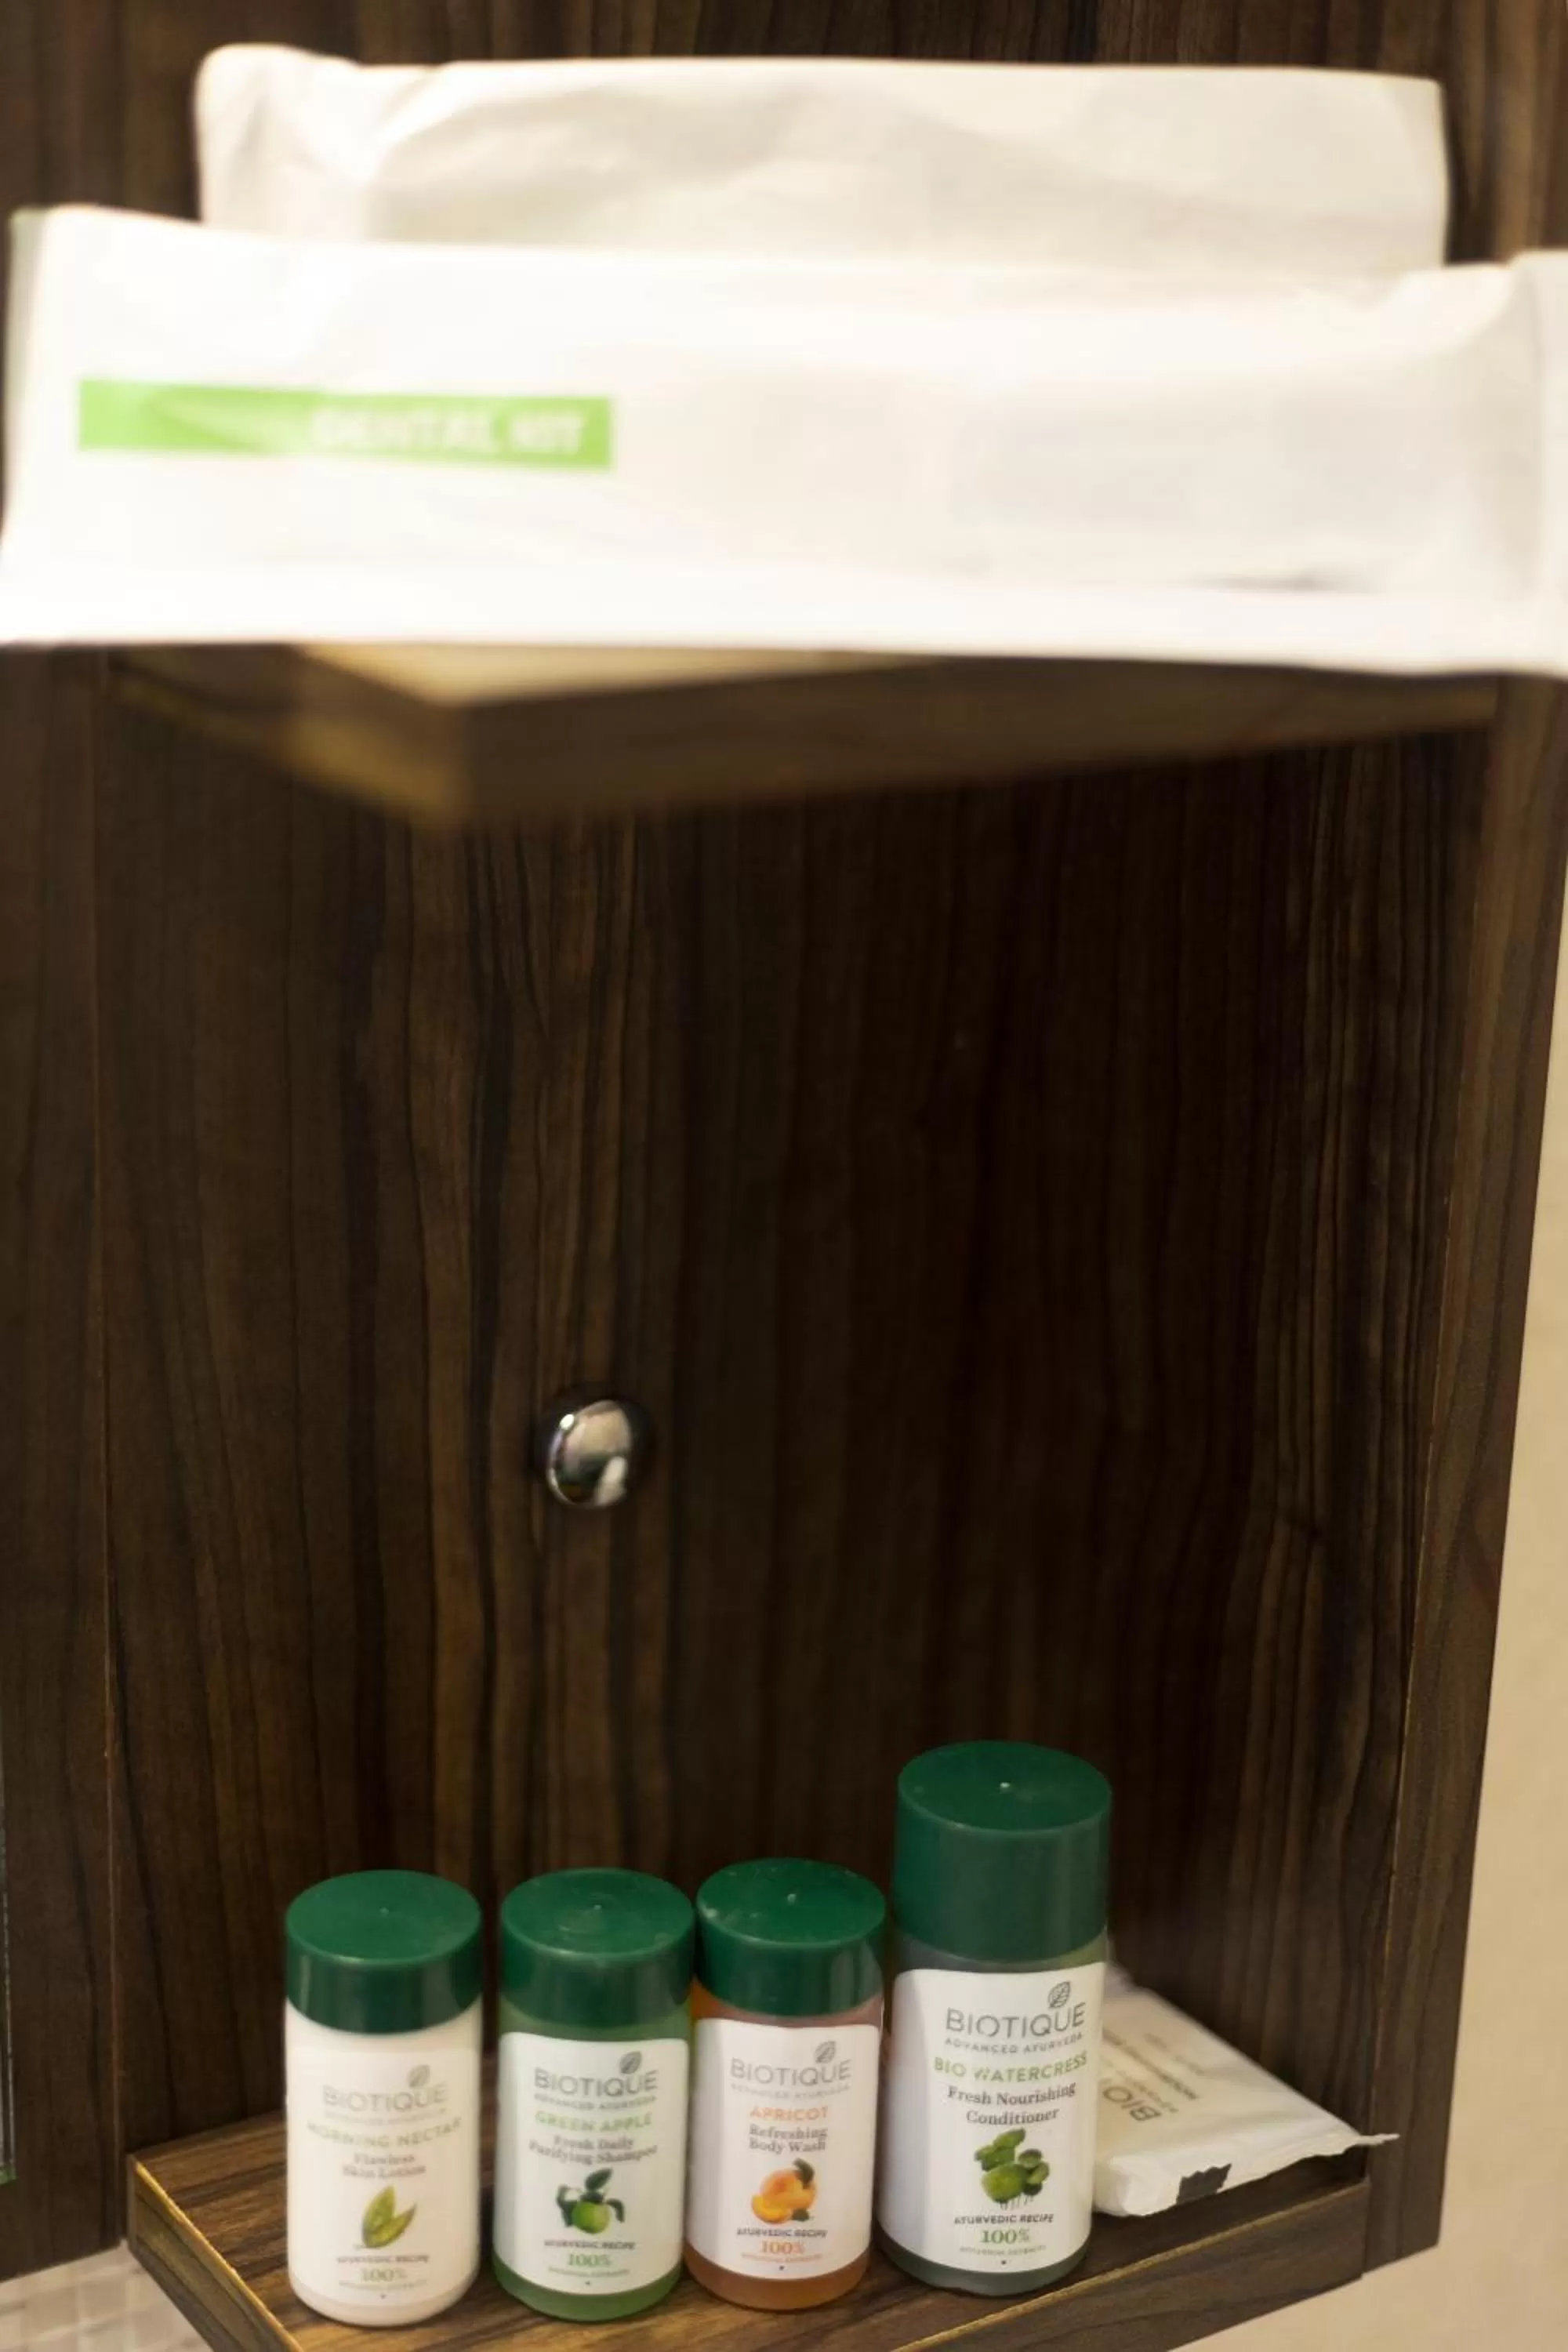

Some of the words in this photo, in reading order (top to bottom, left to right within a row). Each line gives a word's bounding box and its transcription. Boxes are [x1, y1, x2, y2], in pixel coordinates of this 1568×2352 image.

[946, 2002, 1086, 2039] BIOTIQUE
[945, 2038, 1018, 2054] ADVANCED
[1023, 2032, 1083, 2053] AYURVEDA
[731, 2057, 852, 2087] BIOTIQUE
[934, 2056, 967, 2078] BIO
[972, 2051, 1088, 2083] WATERCRESS
[534, 2067, 659, 2098] BIOTIQUE
[946, 2085, 992, 2105] Fresh
[996, 2082, 1076, 2105] Nourishing
[322, 2082, 449, 2113] BIOTIQUE
[535, 2110, 594, 2132] GREEN
[600, 2111, 653, 2132] APPLE
[750, 2105, 829, 2122] APRICOT
[965, 2108, 1061, 2125] Conditioner
[749, 2123, 829, 2140] Refreshing
[749, 2136, 784, 2154] Body
[789, 2139, 826, 2152] Wash
[953, 2214, 1017, 2224] AYURVEDIC
[980, 2228, 1030, 2244] 100%
